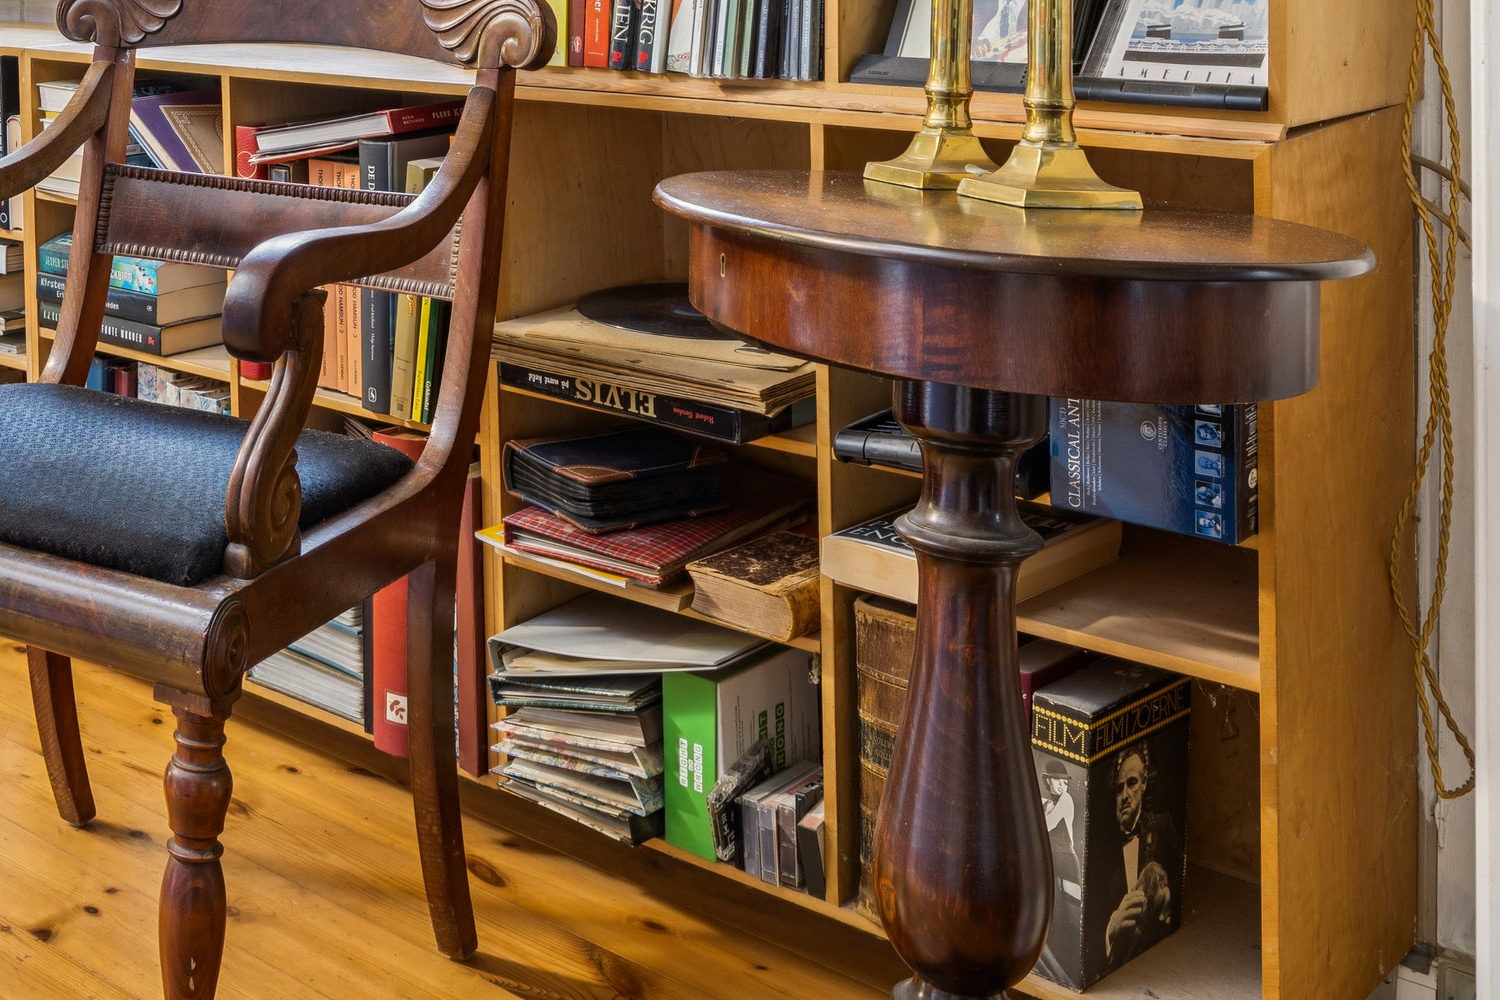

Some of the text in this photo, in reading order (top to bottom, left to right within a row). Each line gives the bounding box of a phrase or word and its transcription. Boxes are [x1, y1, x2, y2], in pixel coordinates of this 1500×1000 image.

[1119, 66, 1255, 85] AMERIKA
[368, 165, 375, 181] DE
[45, 256, 69, 270] JESPER STE
[110, 269, 132, 282] CKBIRD
[40, 277, 65, 290] Kirsten
[561, 379, 570, 390] på
[574, 377, 657, 418] ELVIS
[1059, 407, 1067, 430] 30CD
[1068, 398, 1081, 508] CLASSICAL ANT
[776, 702, 786, 769] RONG
[1035, 713, 1085, 753] FILM
[1096, 716, 1124, 751] FILM
[679, 738, 688, 787] RIGHT
[694, 743, 703, 793] WRONG
